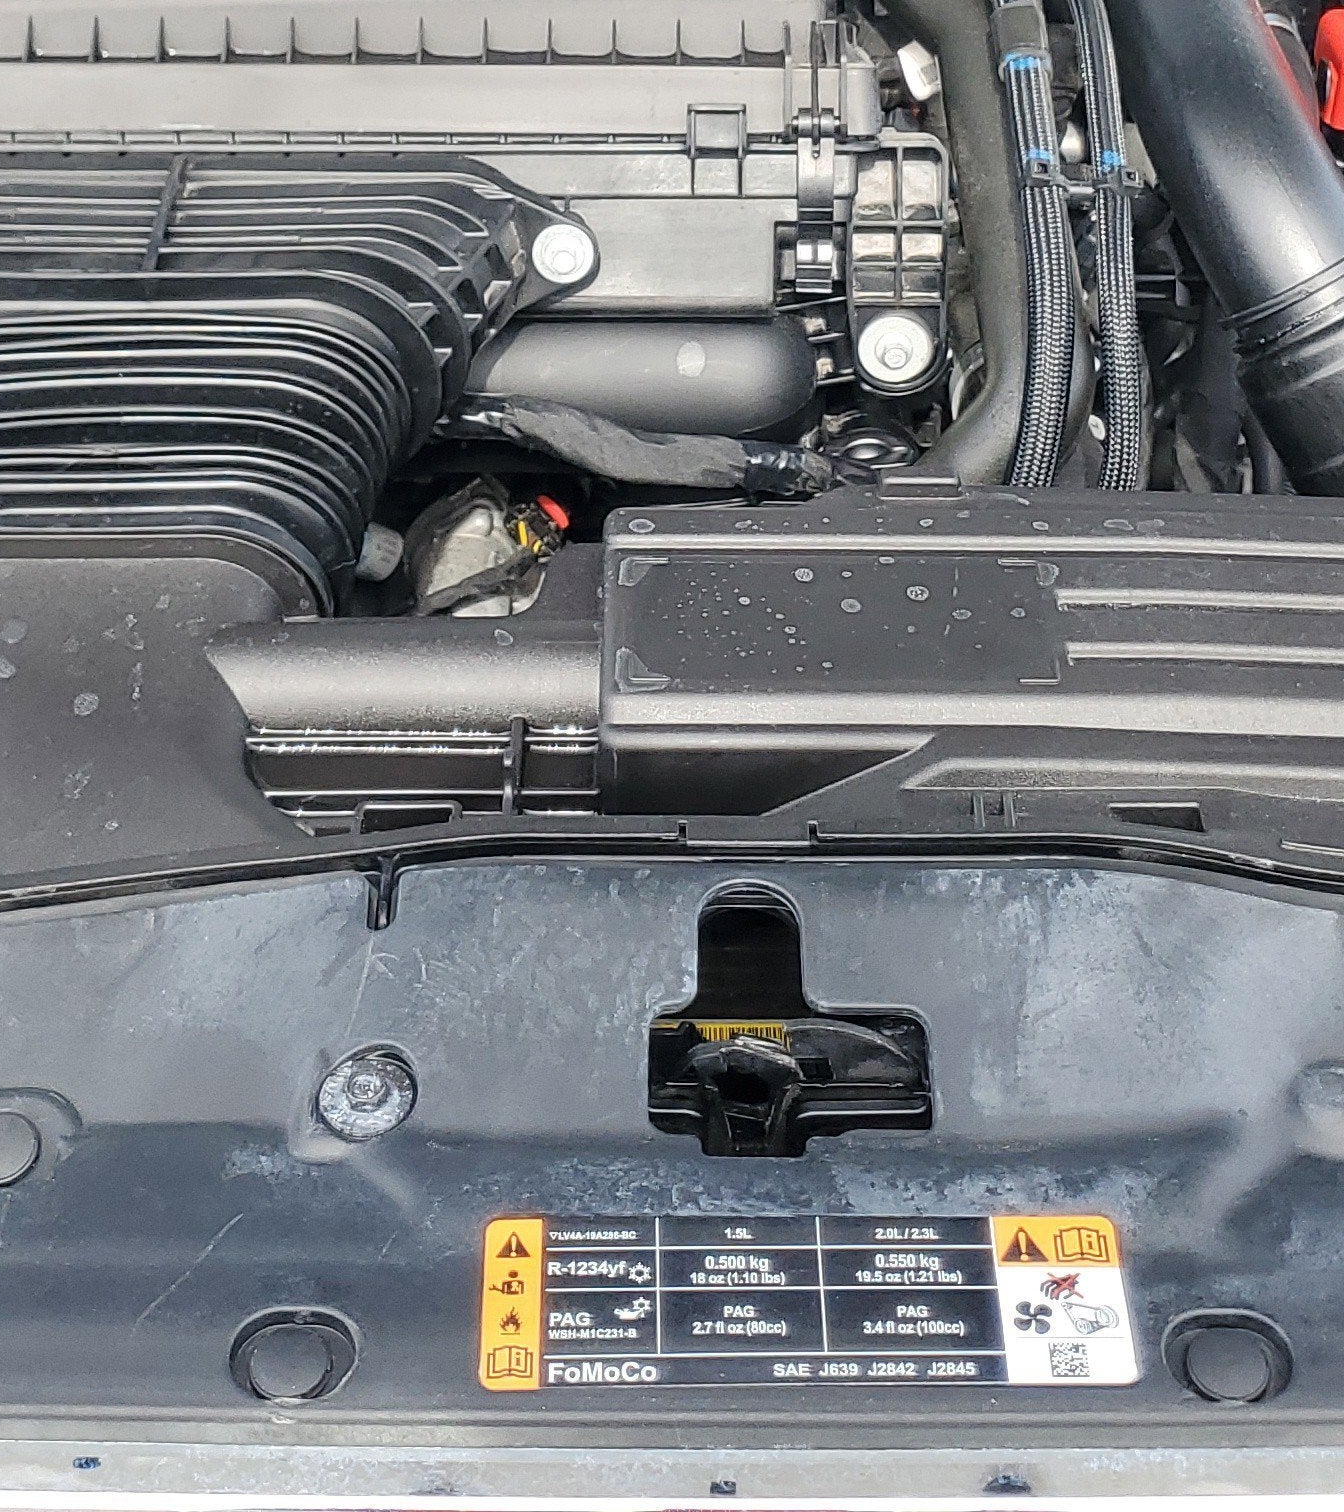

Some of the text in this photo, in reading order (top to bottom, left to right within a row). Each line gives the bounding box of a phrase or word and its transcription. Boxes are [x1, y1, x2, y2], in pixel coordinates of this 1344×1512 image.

[724, 1227, 752, 1239] 1.5L
[875, 1227, 902, 1239] 2.0L
[911, 1227, 939, 1239] 2.3L
[547, 1260, 627, 1278] R-1234yf
[704, 1254, 769, 1274] 0.500 kg
[875, 1252, 939, 1272] 0.550 kg
[690, 1271, 786, 1286] 18 oz (1.10 lbs)
[855, 1269, 963, 1285] 19.5 oz (1.21 lbs)
[549, 1311, 591, 1327] PAG
[723, 1305, 755, 1318] PAG
[897, 1305, 928, 1318] PAG
[692, 1321, 712, 1334] 2.7
[728, 1324, 744, 1334] oz
[746, 1320, 786, 1336] (80cc)
[863, 1321, 883, 1334] 3.4
[898, 1324, 915, 1334] oz
[917, 1320, 965, 1336] (100cc)
[548, 1361, 657, 1383] FoMoCo
[773, 1362, 976, 1377] SAE J639 J2842 J2845
